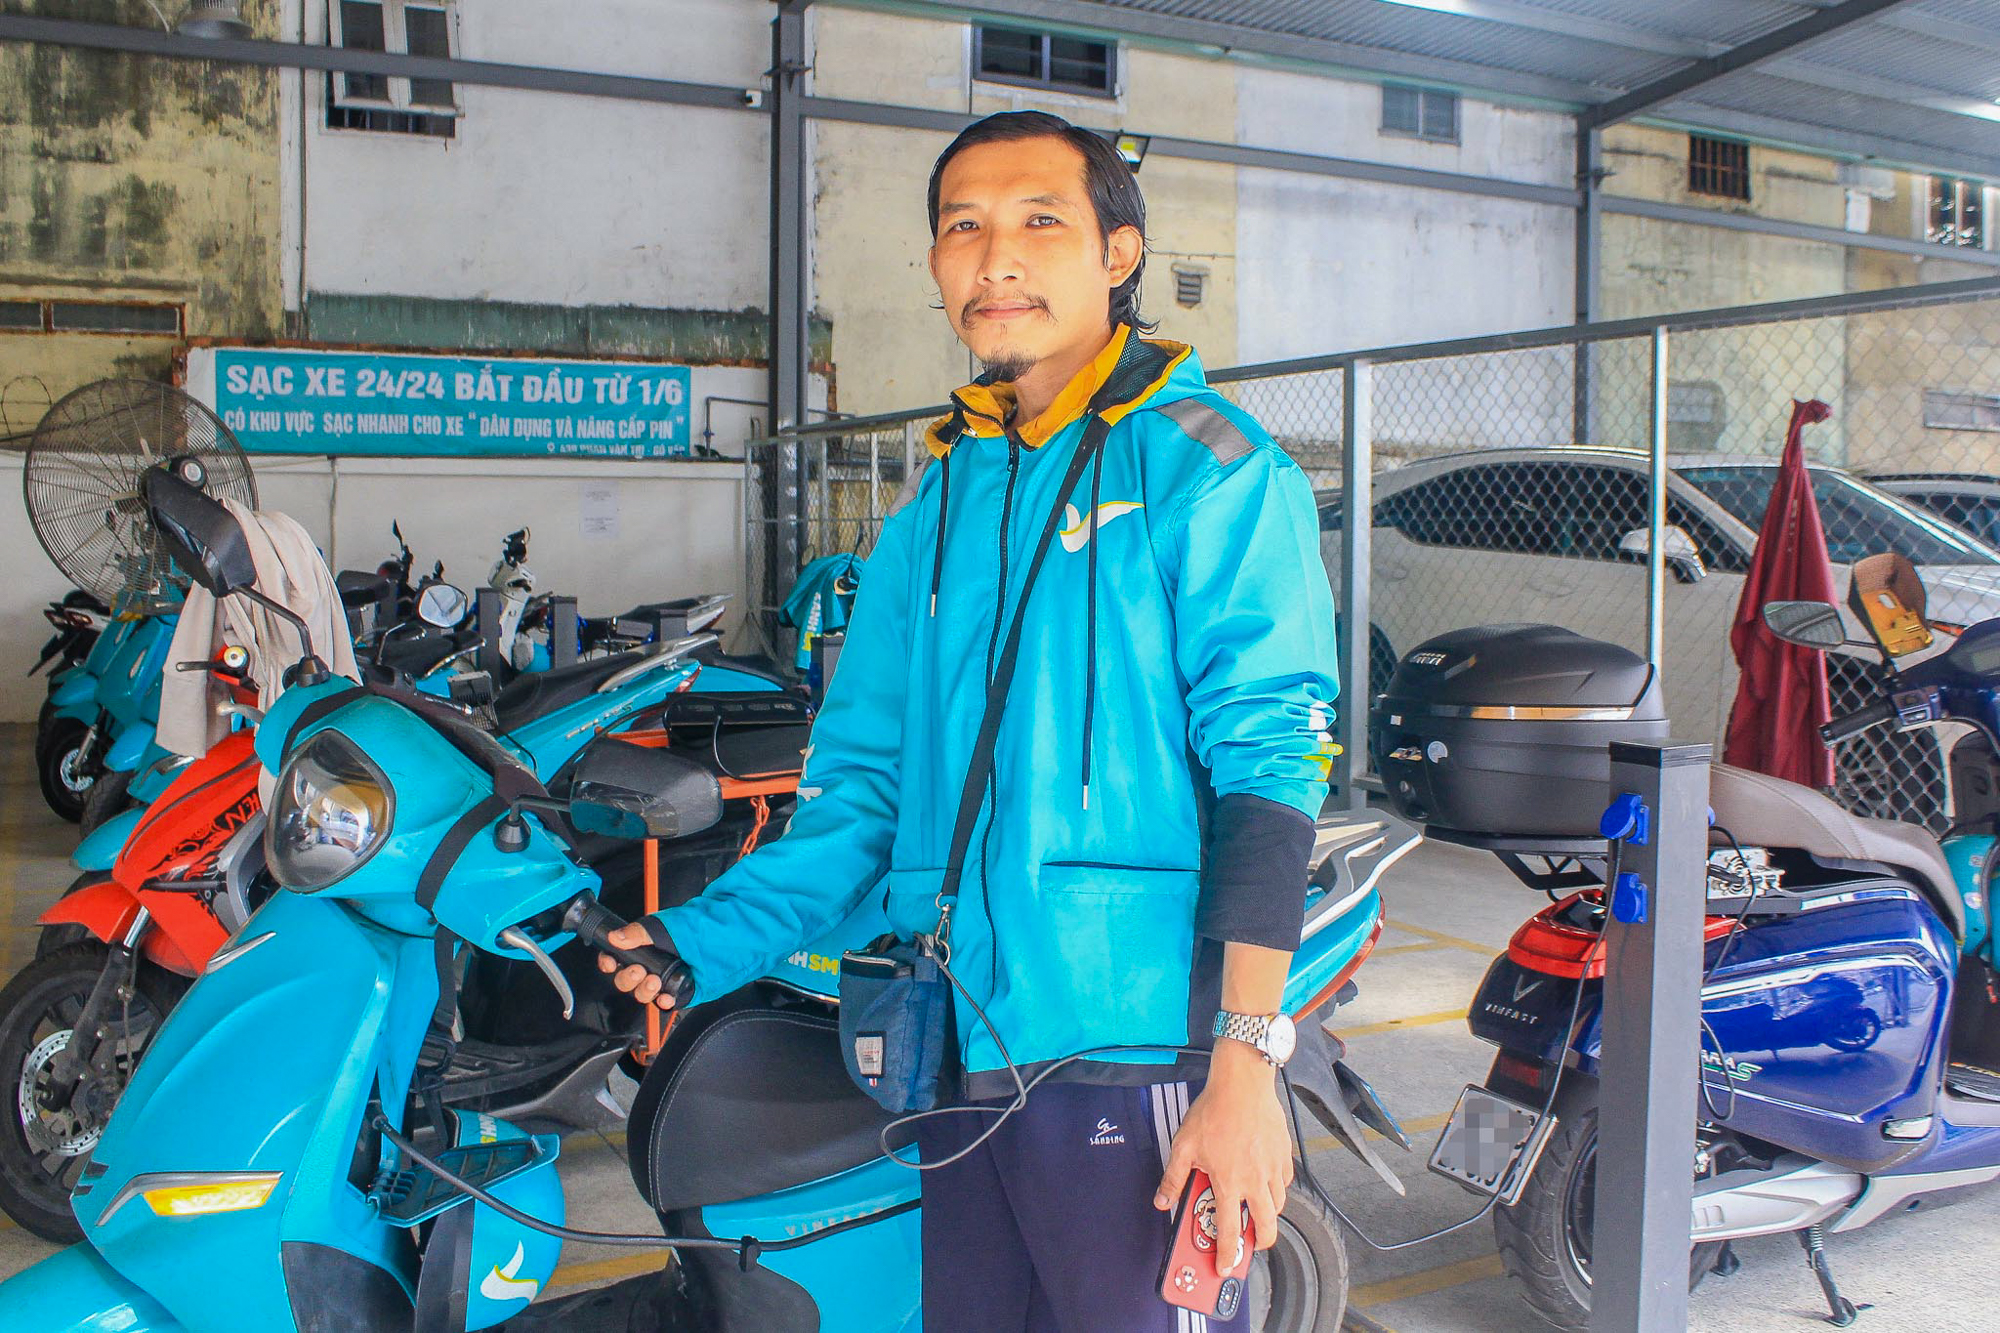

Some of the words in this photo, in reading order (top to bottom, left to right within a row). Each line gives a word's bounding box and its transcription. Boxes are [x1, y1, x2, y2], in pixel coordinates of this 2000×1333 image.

[226, 364, 294, 401] SẠC
[304, 367, 347, 398] XE
[356, 368, 445, 400] 24/24
[454, 363, 513, 402] BẮT
[522, 366, 584, 404] ĐẦU
[592, 372, 633, 405] TỪ
[638, 378, 683, 406] 1/6
[224, 406, 246, 432] CÓ
[250, 410, 281, 433] KHU
[284, 408, 315, 437] VỰC
[323, 412, 353, 438] SẠC
[357, 413, 409, 435] NHANH
[412, 415, 442, 436] CHO
[445, 415, 464, 437] XE
[479, 413, 510, 438] DÂN
[513, 417, 552, 441] DỤNG
[555, 415, 574, 439] VÀ
[576, 415, 615, 439] NÂNG
[618, 413, 646, 439] CẤP
[649, 419, 673, 440] PIN
